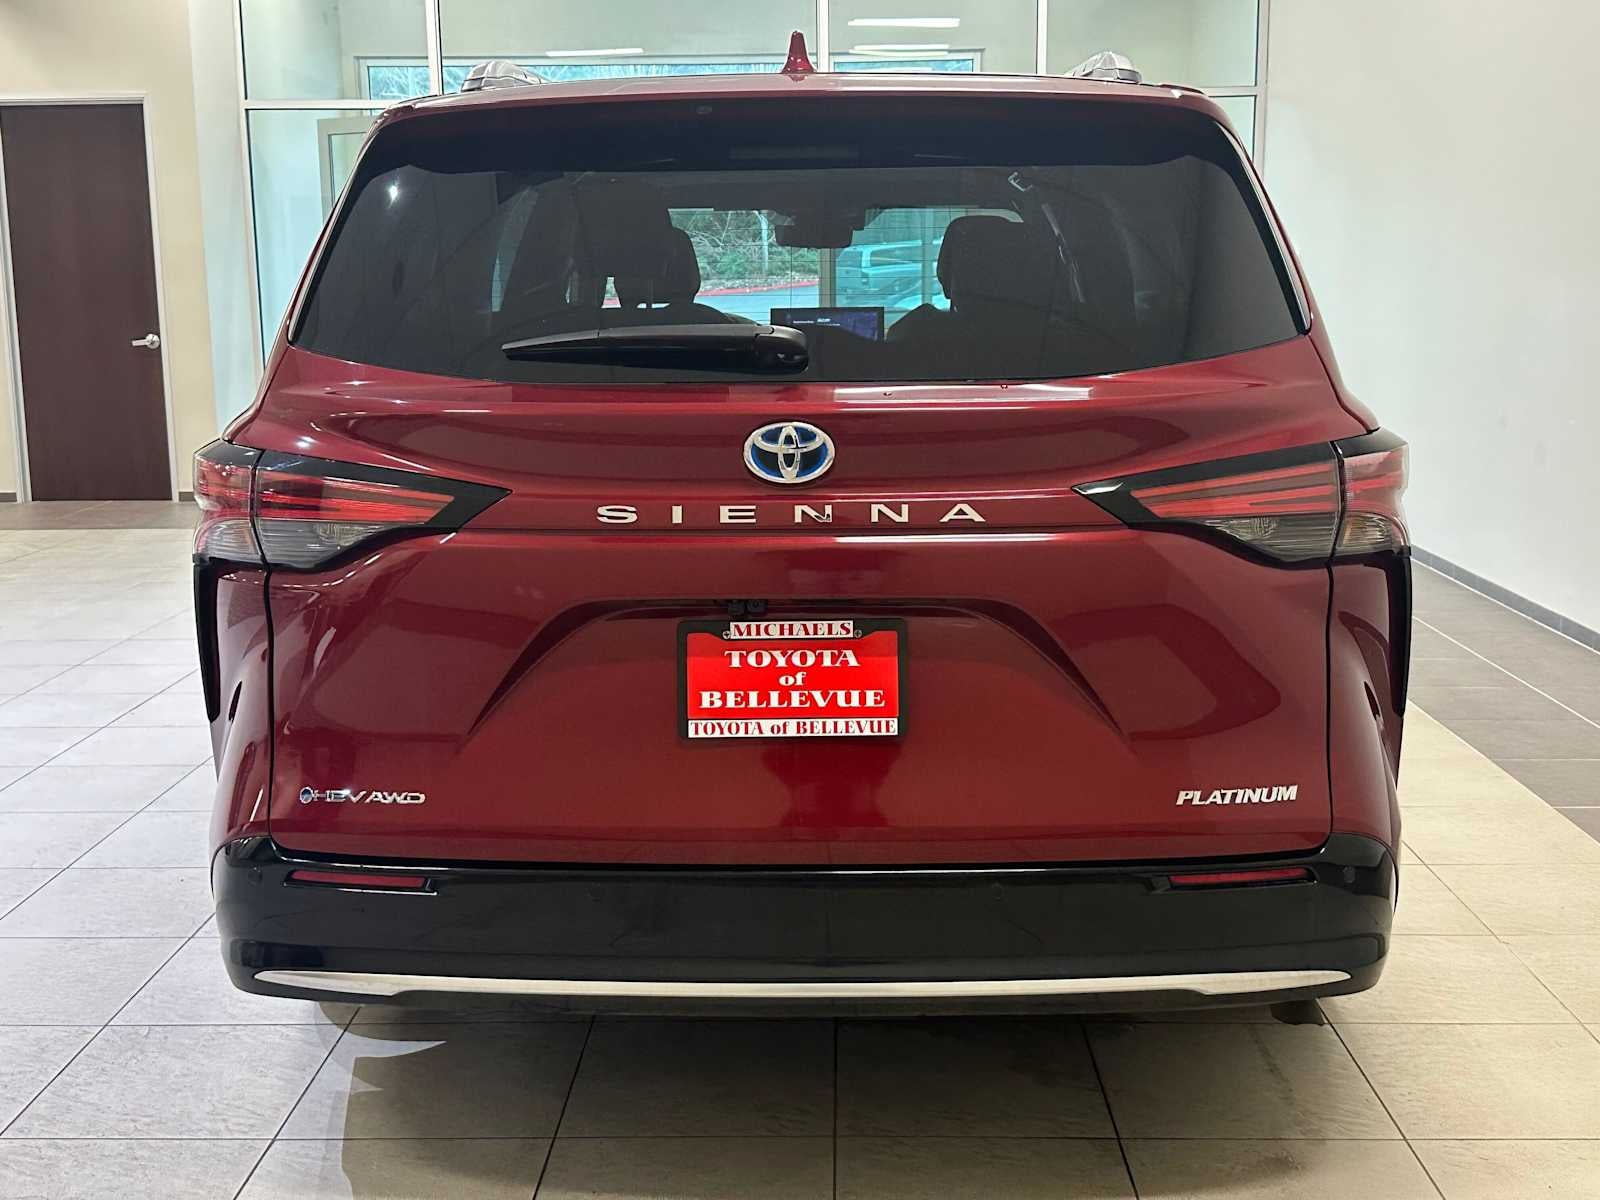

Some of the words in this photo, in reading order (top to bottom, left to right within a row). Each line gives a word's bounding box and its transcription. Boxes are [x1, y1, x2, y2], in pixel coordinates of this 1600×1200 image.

[596, 503, 986, 524] SIENNA
[733, 622, 851, 637] MICHAELS
[724, 650, 860, 668] TOYOTA
[778, 671, 807, 687] of
[699, 690, 886, 709] BELLEVUE
[689, 721, 764, 736] TOYOTA
[770, 720, 789, 735] of
[796, 719, 896, 735] BELLEVUE
[1176, 785, 1298, 805] PLATINUM
